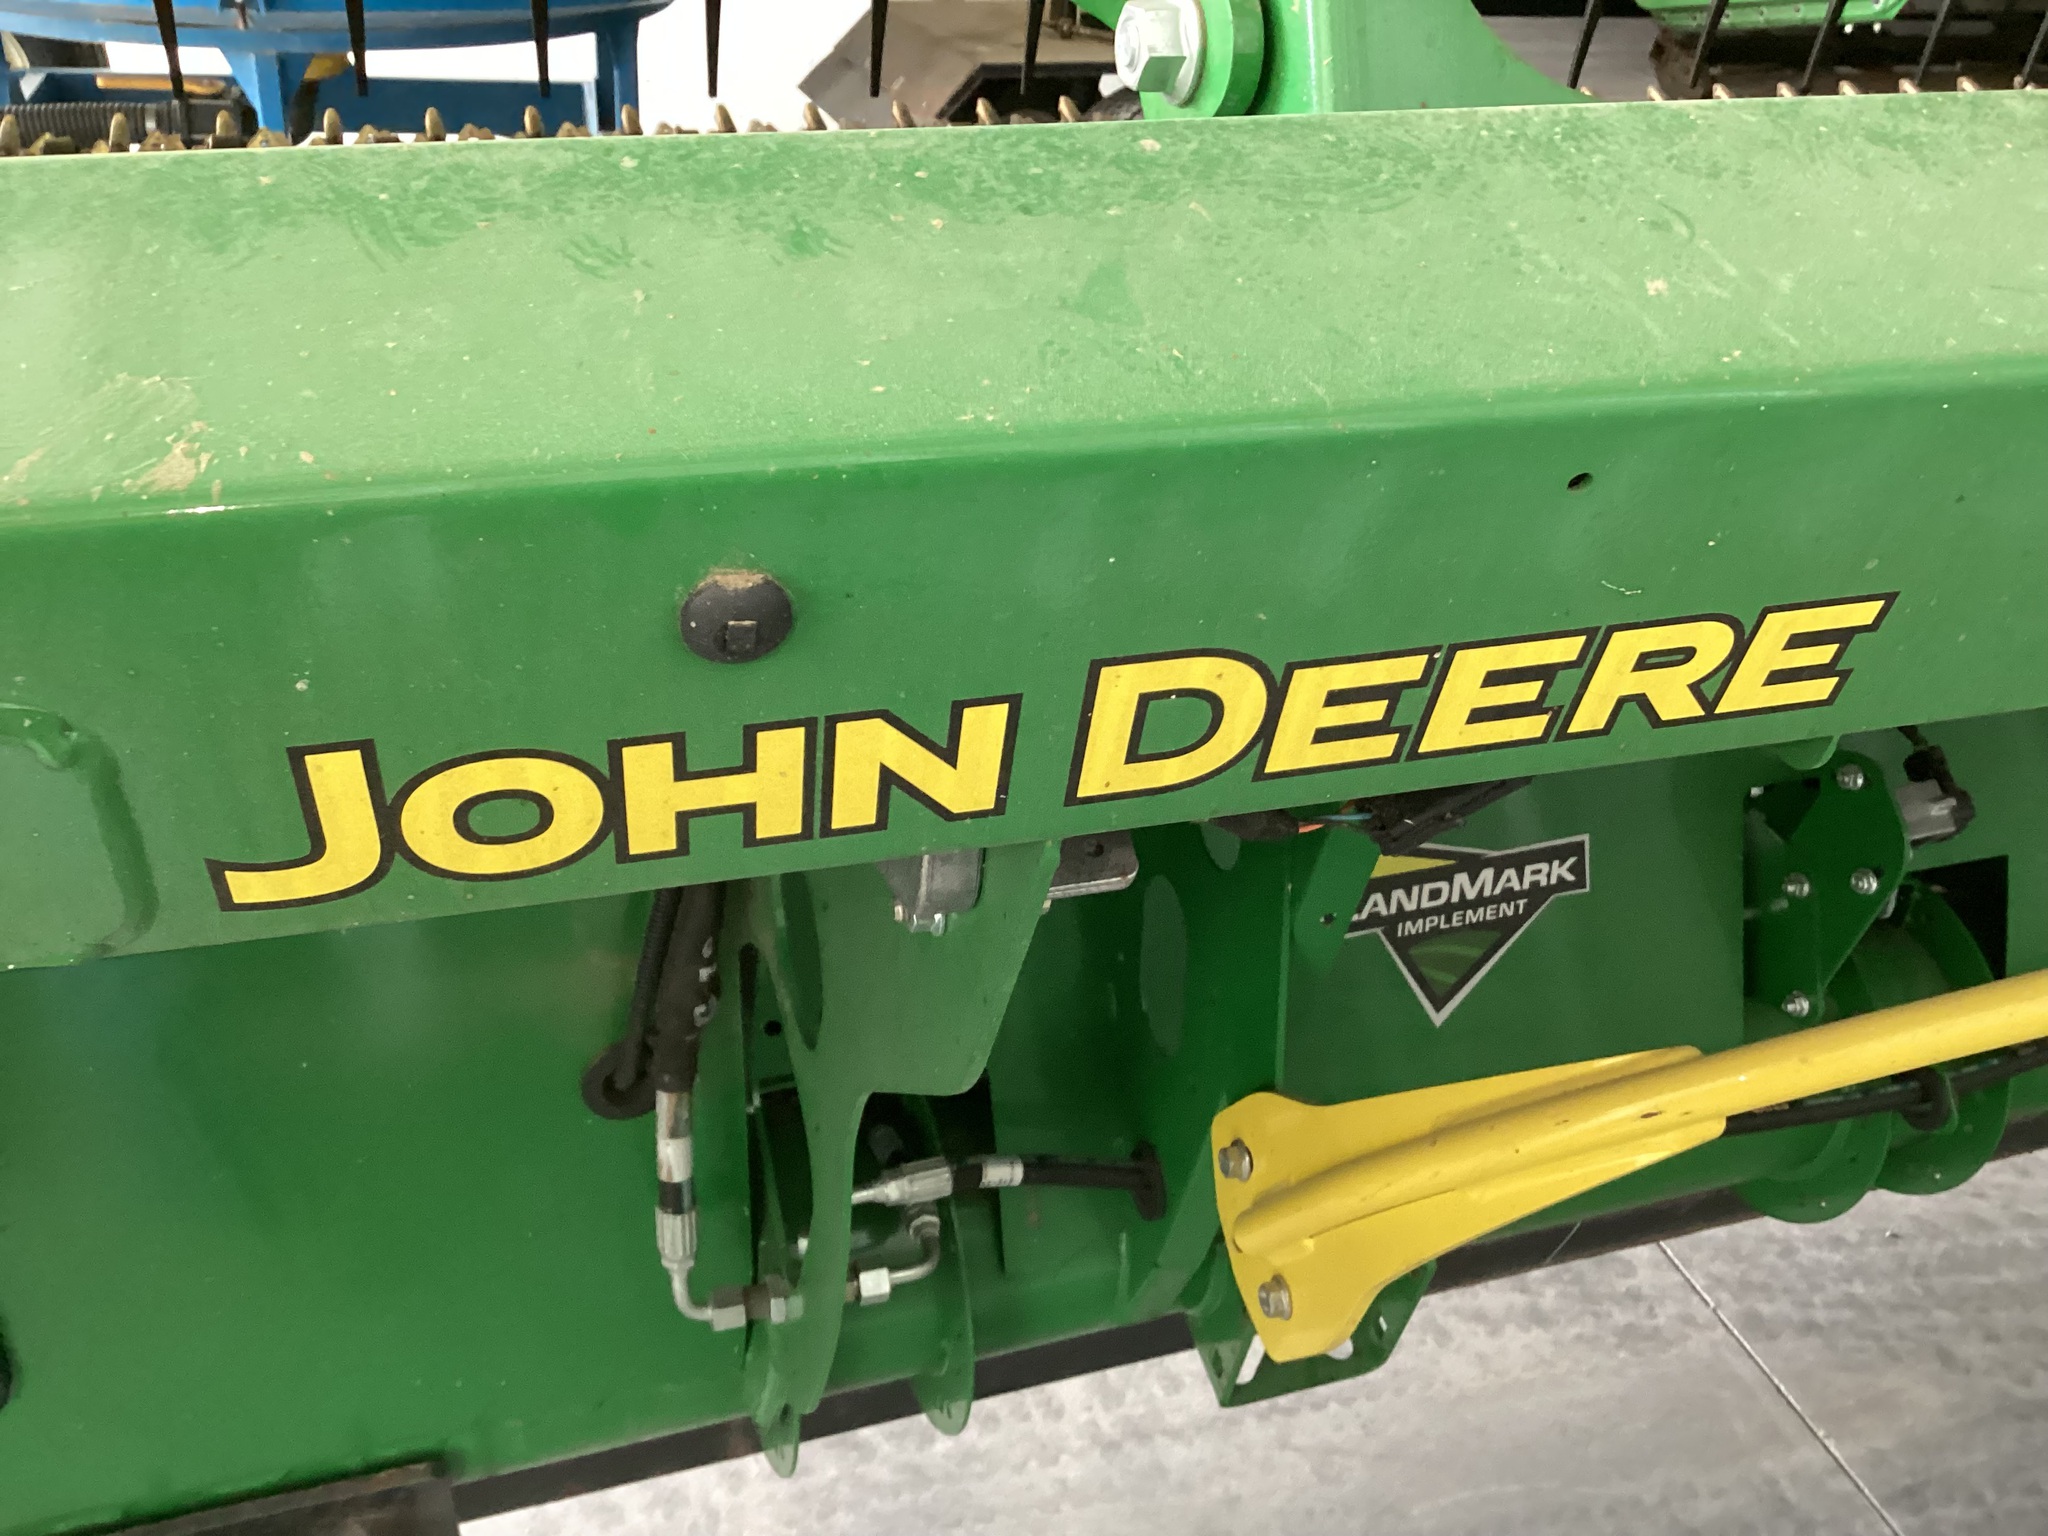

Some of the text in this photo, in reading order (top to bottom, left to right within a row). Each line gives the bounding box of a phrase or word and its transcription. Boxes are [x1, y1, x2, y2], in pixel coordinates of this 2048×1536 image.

[208, 595, 1892, 908] JOHN DEERE
[1352, 856, 1578, 921] ANDMARK
[1397, 898, 1528, 937] IMPLEMENT
